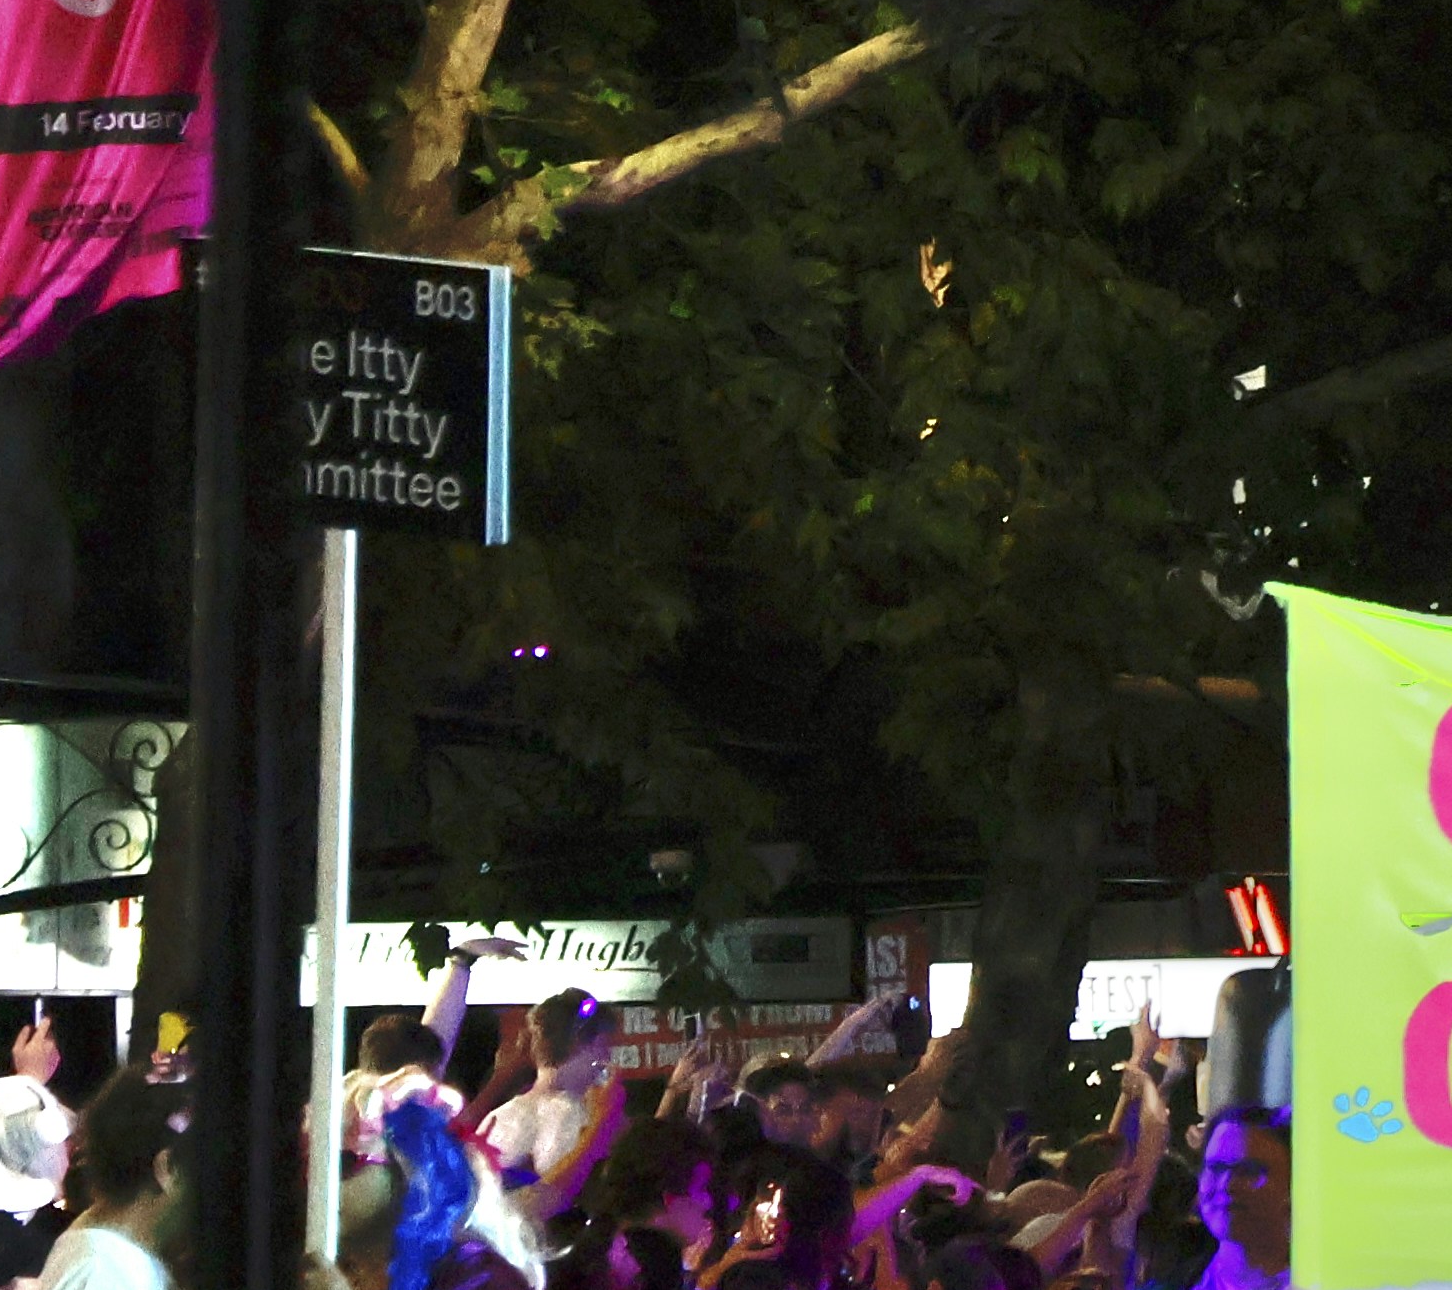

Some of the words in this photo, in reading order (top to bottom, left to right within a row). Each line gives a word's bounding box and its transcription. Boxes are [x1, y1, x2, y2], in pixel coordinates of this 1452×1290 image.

[41, 112, 70, 137] 14
[415, 279, 476, 321] B03
[348, 330, 423, 395] Itty
[341, 390, 447, 459] Titty
[304, 452, 462, 511] mittee
